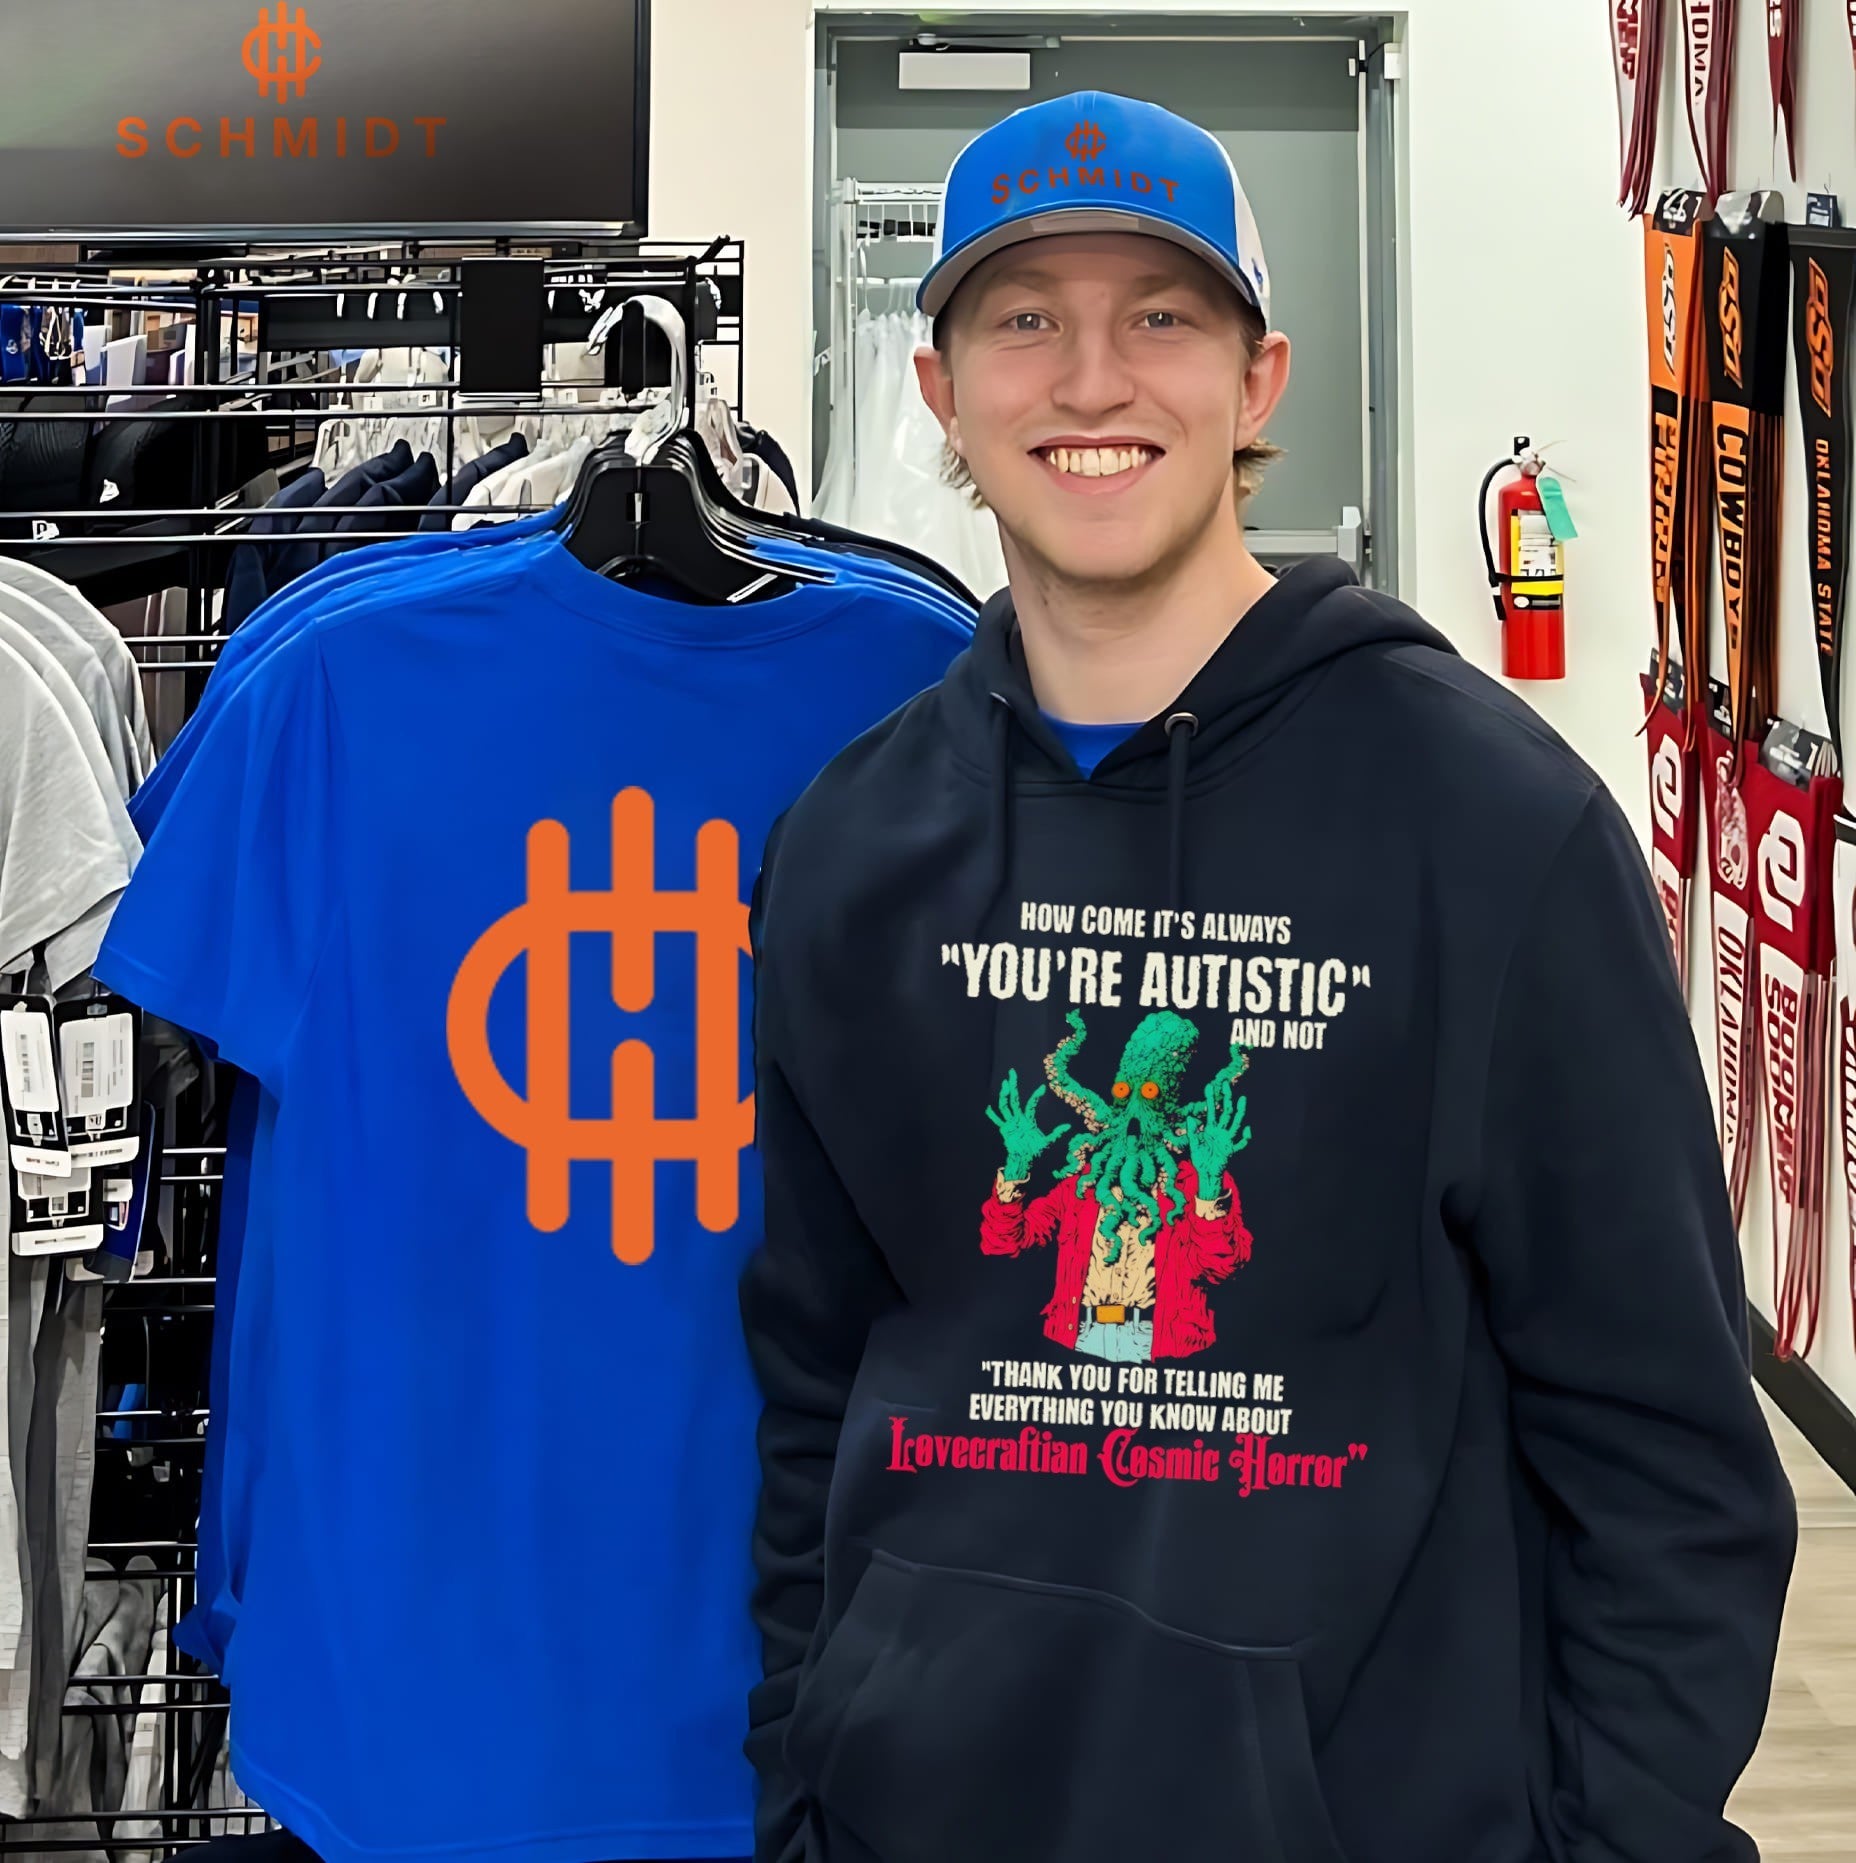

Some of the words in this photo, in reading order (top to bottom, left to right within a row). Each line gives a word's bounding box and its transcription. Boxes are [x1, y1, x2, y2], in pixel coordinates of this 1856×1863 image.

[116, 116, 446, 158] SCHMIDT
[991, 167, 1179, 204] SCHMIDT
[1815, 438, 1833, 571] OKLAHOMA
[1021, 902, 1075, 933] HOW
[1082, 905, 1145, 937] COME
[1154, 910, 1195, 939] IT'S
[1202, 913, 1291, 944] ALWAYS
[1139, 952, 1370, 1016] AUTISTIC"
[1230, 1019, 1275, 1047] AND
[1283, 1021, 1327, 1050] NOT
[1718, 926, 1745, 1144] OKLAHOMA
[982, 1361, 1062, 1390] "THANK
[1070, 1364, 1111, 1392] YOU
[1118, 1367, 1157, 1394] FOR
[1164, 1369, 1246, 1399] TELLING
[1253, 1374, 1283, 1401] ME
[970, 1393, 1094, 1427] EVERYTHING
[1101, 1400, 1143, 1427] YOU
[1150, 1403, 1216, 1432] KNOW
[1222, 1407, 1292, 1435] ABOUT
[887, 1417, 1087, 1474] Lovecraftian
[1097, 1428, 1219, 1487] Cosmic
